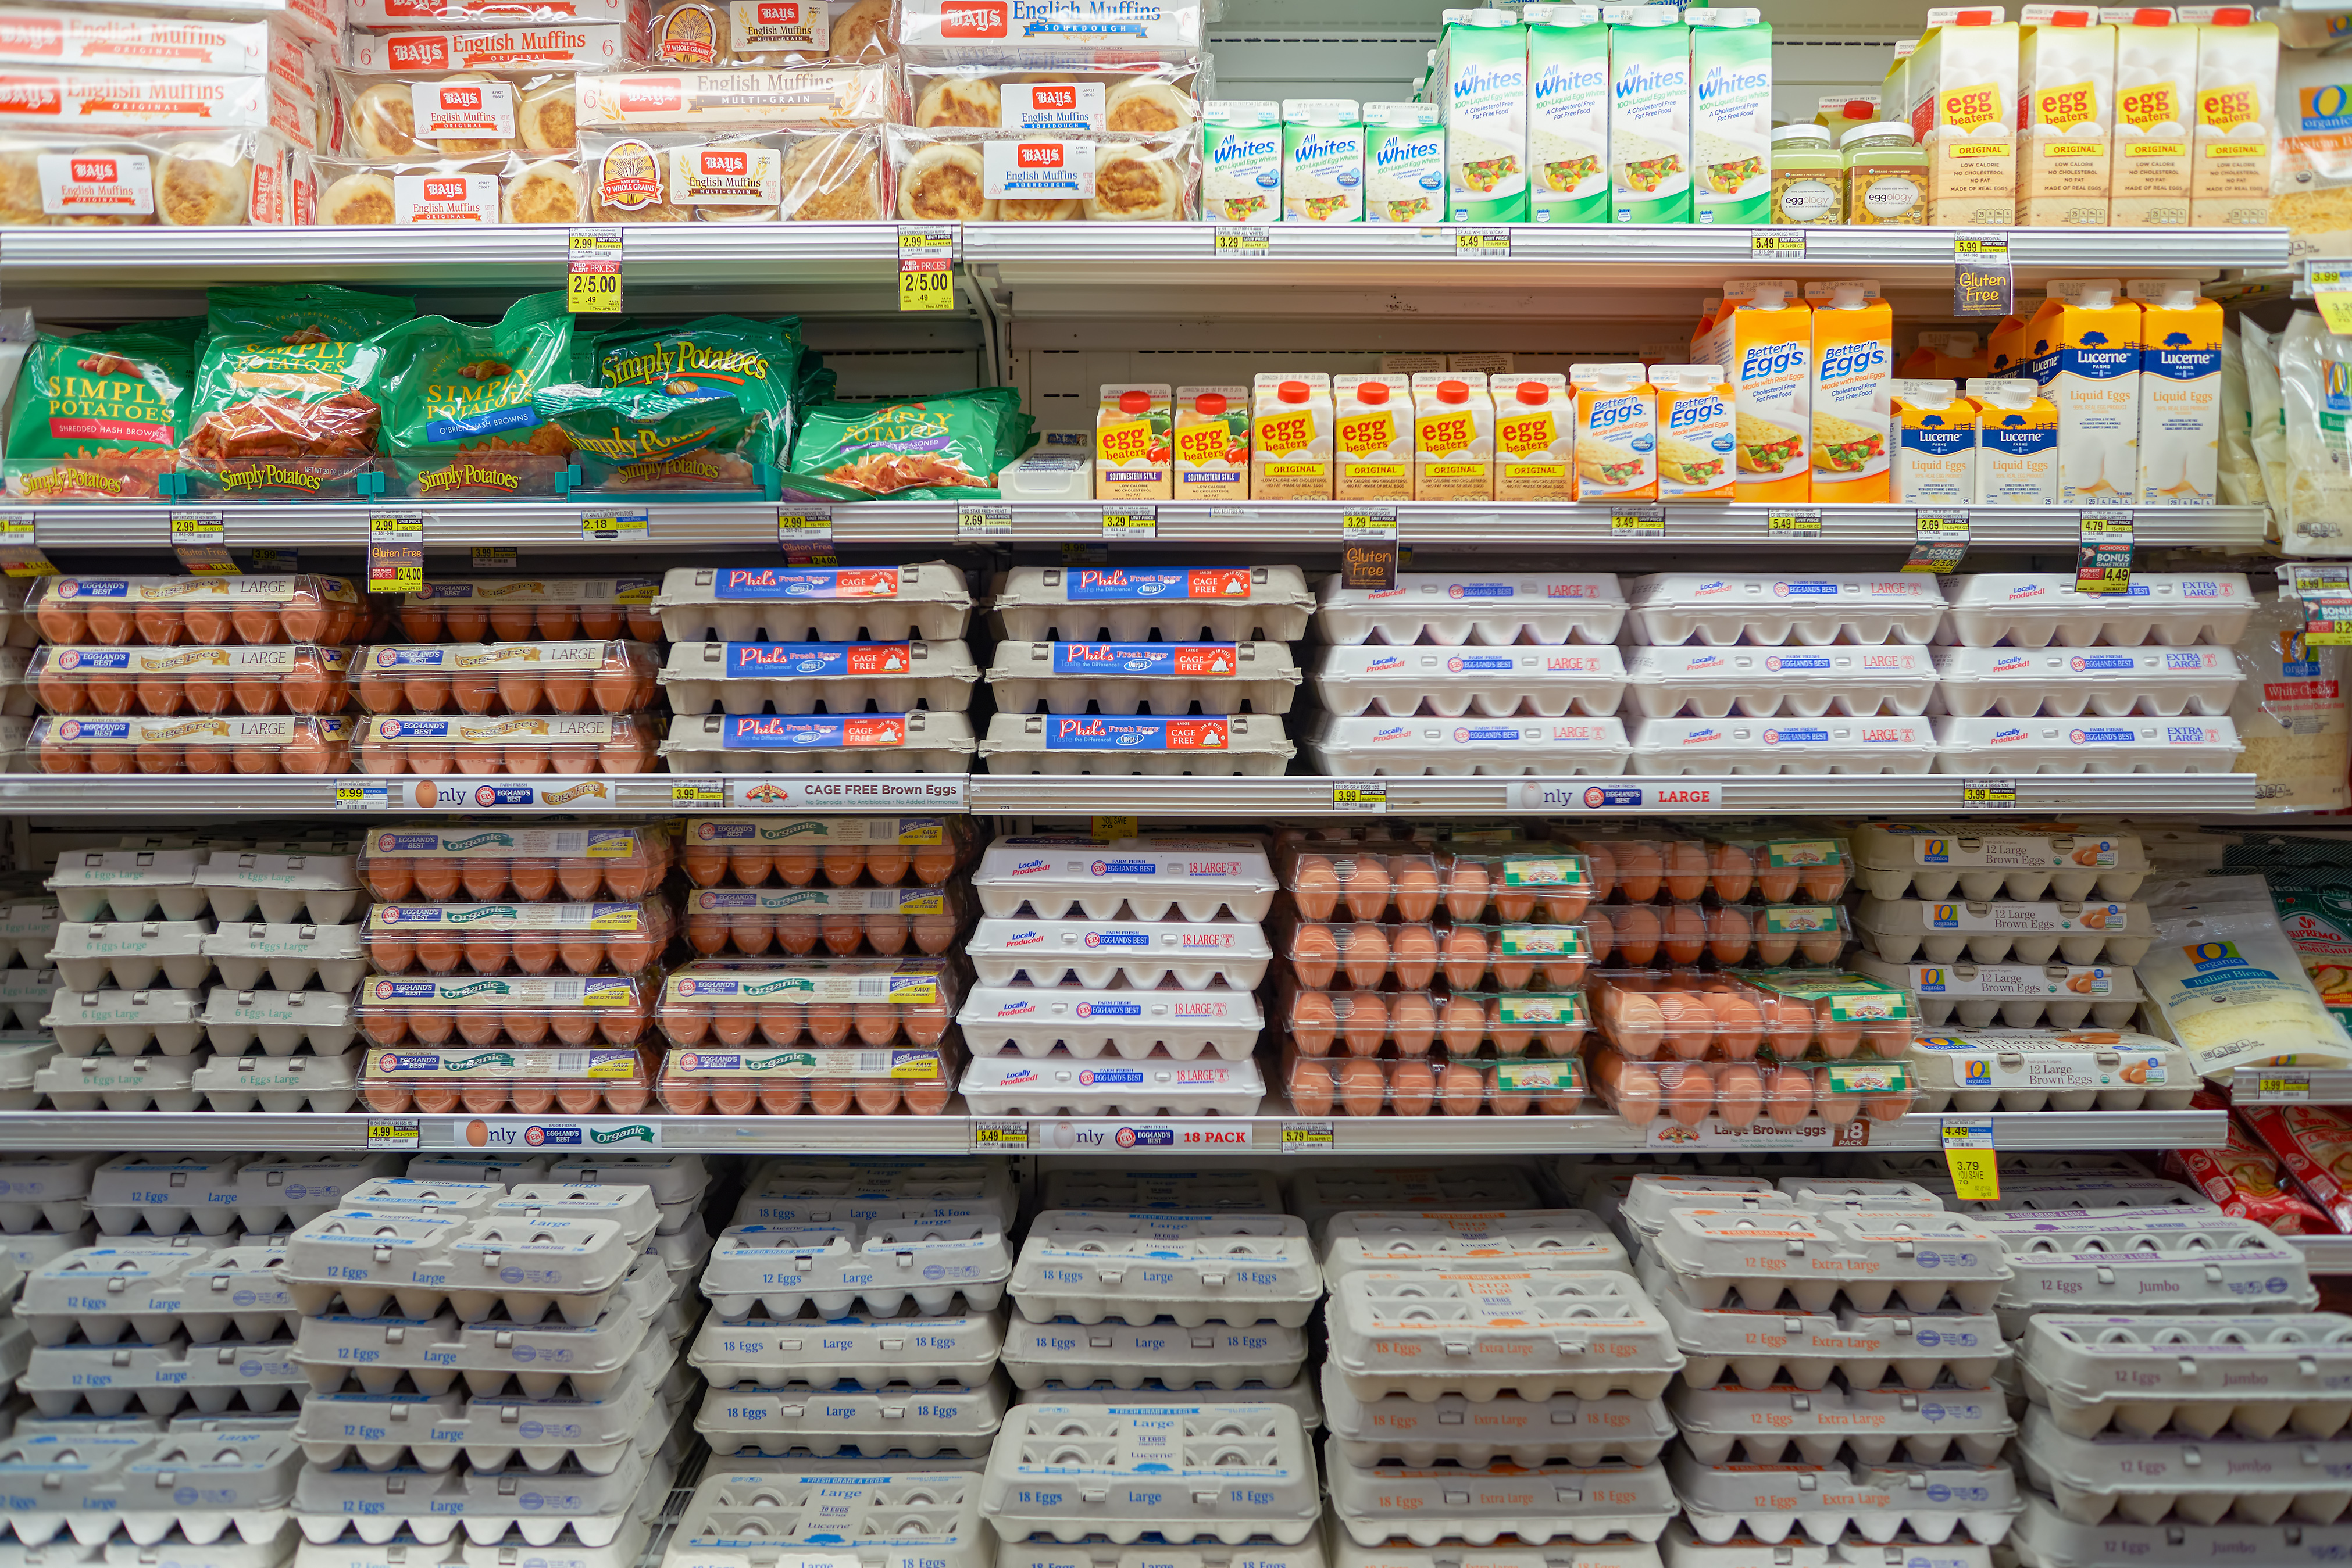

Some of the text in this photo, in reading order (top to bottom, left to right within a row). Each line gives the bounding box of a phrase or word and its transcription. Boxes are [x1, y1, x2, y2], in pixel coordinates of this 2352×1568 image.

[748, 26, 811, 37] English Muffins
[690, 47, 709, 56] GRAINS
[1462, 64, 1476, 78] All
[1454, 72, 1522, 98] Whites
[1455, 101, 1470, 109] 100%
[1471, 96, 1490, 105] Liquid
[1470, 102, 1501, 113] Cholesterol
[1947, 91, 1992, 115] egg
[1950, 113, 1993, 125] beaters
[1006, 170, 1077, 182] English Muffins
[1869, 193, 1911, 202] eggology
[574, 238, 592, 248] 2.99
[1220, 237, 1239, 247] 3.29
[1756, 238, 1774, 248] 5.49
[1960, 242, 1976, 252] 5.99
[574, 276, 616, 293] 2/5.00
[1960, 272, 2006, 286] Gluten
[1966, 287, 1998, 301] Free
[1747, 342, 1797, 359] Better'n
[2078, 351, 2127, 363] Lucerne
[1741, 351, 1803, 381] Eggs
[1742, 381, 1760, 391] Made
[2071, 390, 2130, 402] Liquid Eggs
[49, 401, 172, 424] POTATOES
[59, 423, 165, 438] SHREDDED HASH BROWNS
[20, 466, 122, 496] Simply Potatoes
[1109, 472, 1157, 481] SOUTHWESTERN STYLE
[376, 521, 392, 530] 2.99
[1922, 520, 1939, 529] 2.69
[2086, 521, 2103, 530] 4.79
[372, 548, 422, 558] Gluten Free
[2097, 553, 2129, 562] BONUS
[399, 568, 421, 580] 2/4.00
[1080, 569, 1128, 588] Phil's
[2106, 569, 2128, 581] 4.49
[241, 652, 287, 664] LARGE
[1998, 656, 2022, 665] Locally
[2166, 653, 2201, 661] EXTRA
[1993, 660, 2029, 673] Produced!
[805, 785, 956, 796] CAGE FREE Brown Eggs
[1339, 791, 1357, 802] 3.99
[1658, 791, 1710, 802] LARGE
[1995, 910, 2035, 920] 12 Large
[1995, 920, 2054, 930] Brown Eggs
[2287, 930, 2342, 941] SUPREMO
[87, 940, 147, 952] 6 Eggs Large
[2194, 969, 2268, 985] Italian Blend
[597, 1126, 644, 1144] Organic
[981, 1131, 998, 1141] 5.49
[1945, 1127, 1968, 1135] 4.49
[1184, 1133, 1246, 1142] 18 PACK
[1957, 1162, 1979, 1170] 3.79
[1957, 1171, 1983, 1179] YOU SAVE
[1812, 1259, 1880, 1273] Extra Large
[1043, 1270, 1083, 1283] 18 Eggs
[2139, 1280, 2180, 1294] Jumbo
[820, 1489, 862, 1499] Large
